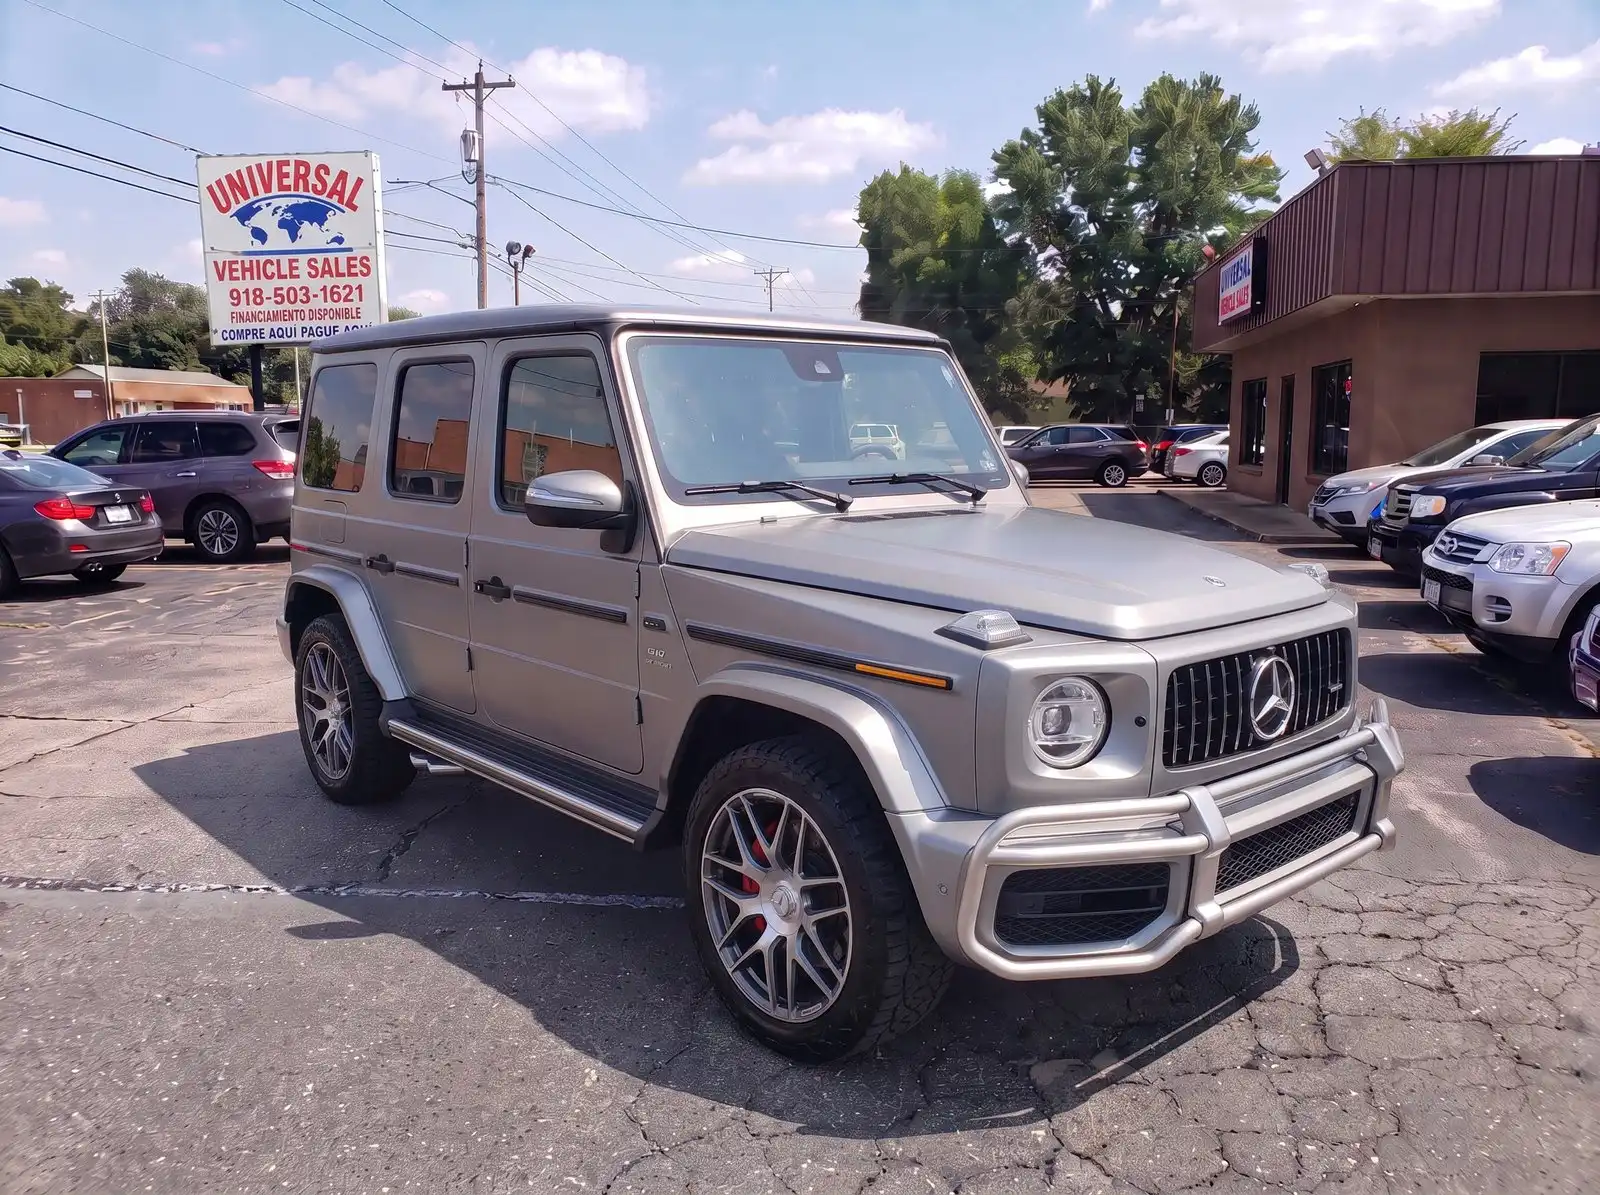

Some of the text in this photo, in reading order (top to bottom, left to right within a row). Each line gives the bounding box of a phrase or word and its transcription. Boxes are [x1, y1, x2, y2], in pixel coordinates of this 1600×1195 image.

[206, 159, 364, 214] UNIVERSAL
[213, 255, 371, 281] VEHICLE SALES
[229, 284, 363, 307] 918-503-1621
[230, 307, 361, 324] FINANCIAMIENTO DISPONIBLE
[221, 328, 265, 341] COMPRE
[301, 325, 339, 338] PAGUE
